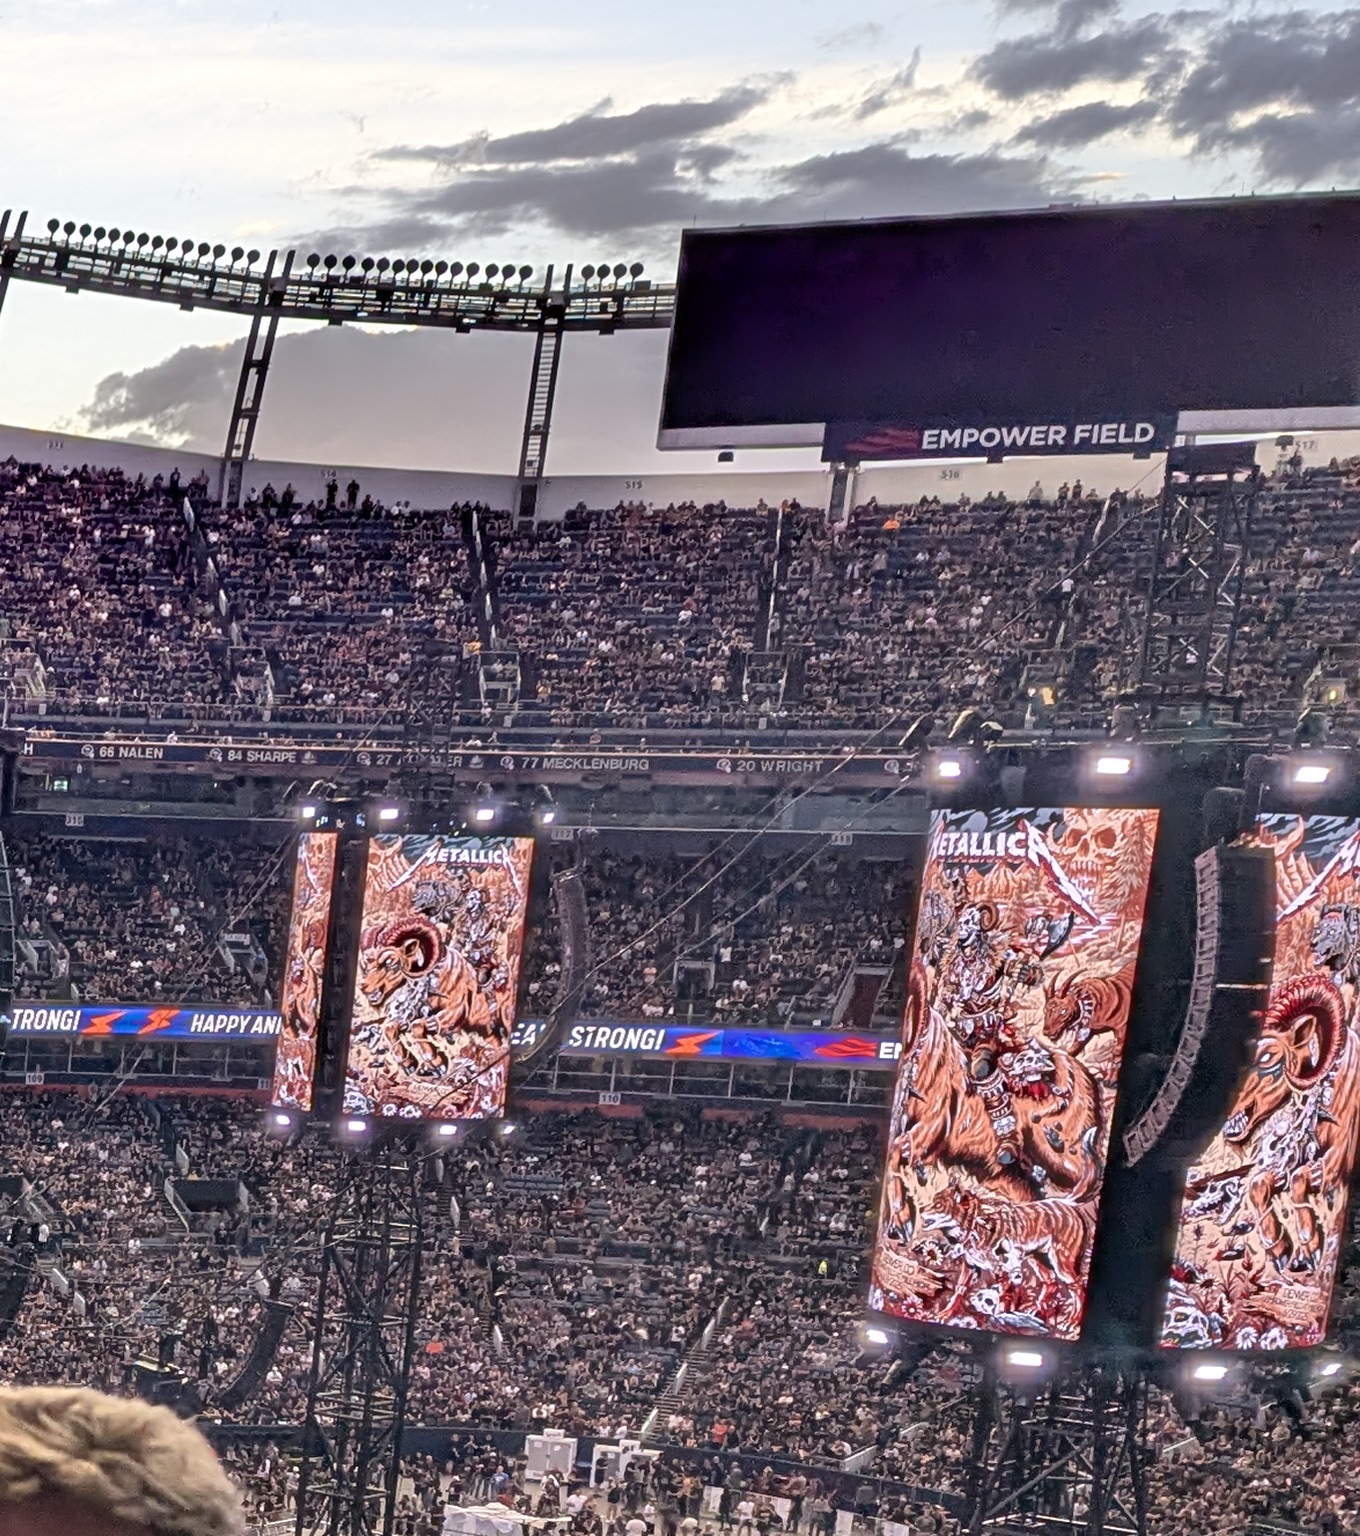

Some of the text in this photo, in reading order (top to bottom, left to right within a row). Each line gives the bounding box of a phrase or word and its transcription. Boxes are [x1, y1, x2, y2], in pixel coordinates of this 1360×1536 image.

[922, 422, 1155, 451] EMPOWER FIELD
[99, 745, 163, 760] 66 NALEN
[227, 749, 297, 763] 84 SHARPE
[377, 754, 393, 766] 27
[522, 758, 650, 771] 77 MECKLENBURG
[737, 761, 824, 773] 20 WRIGHT
[11, 1008, 81, 1031] TRONG!
[190, 1013, 250, 1034] HAPPY
[569, 1026, 665, 1052] STRONG!
